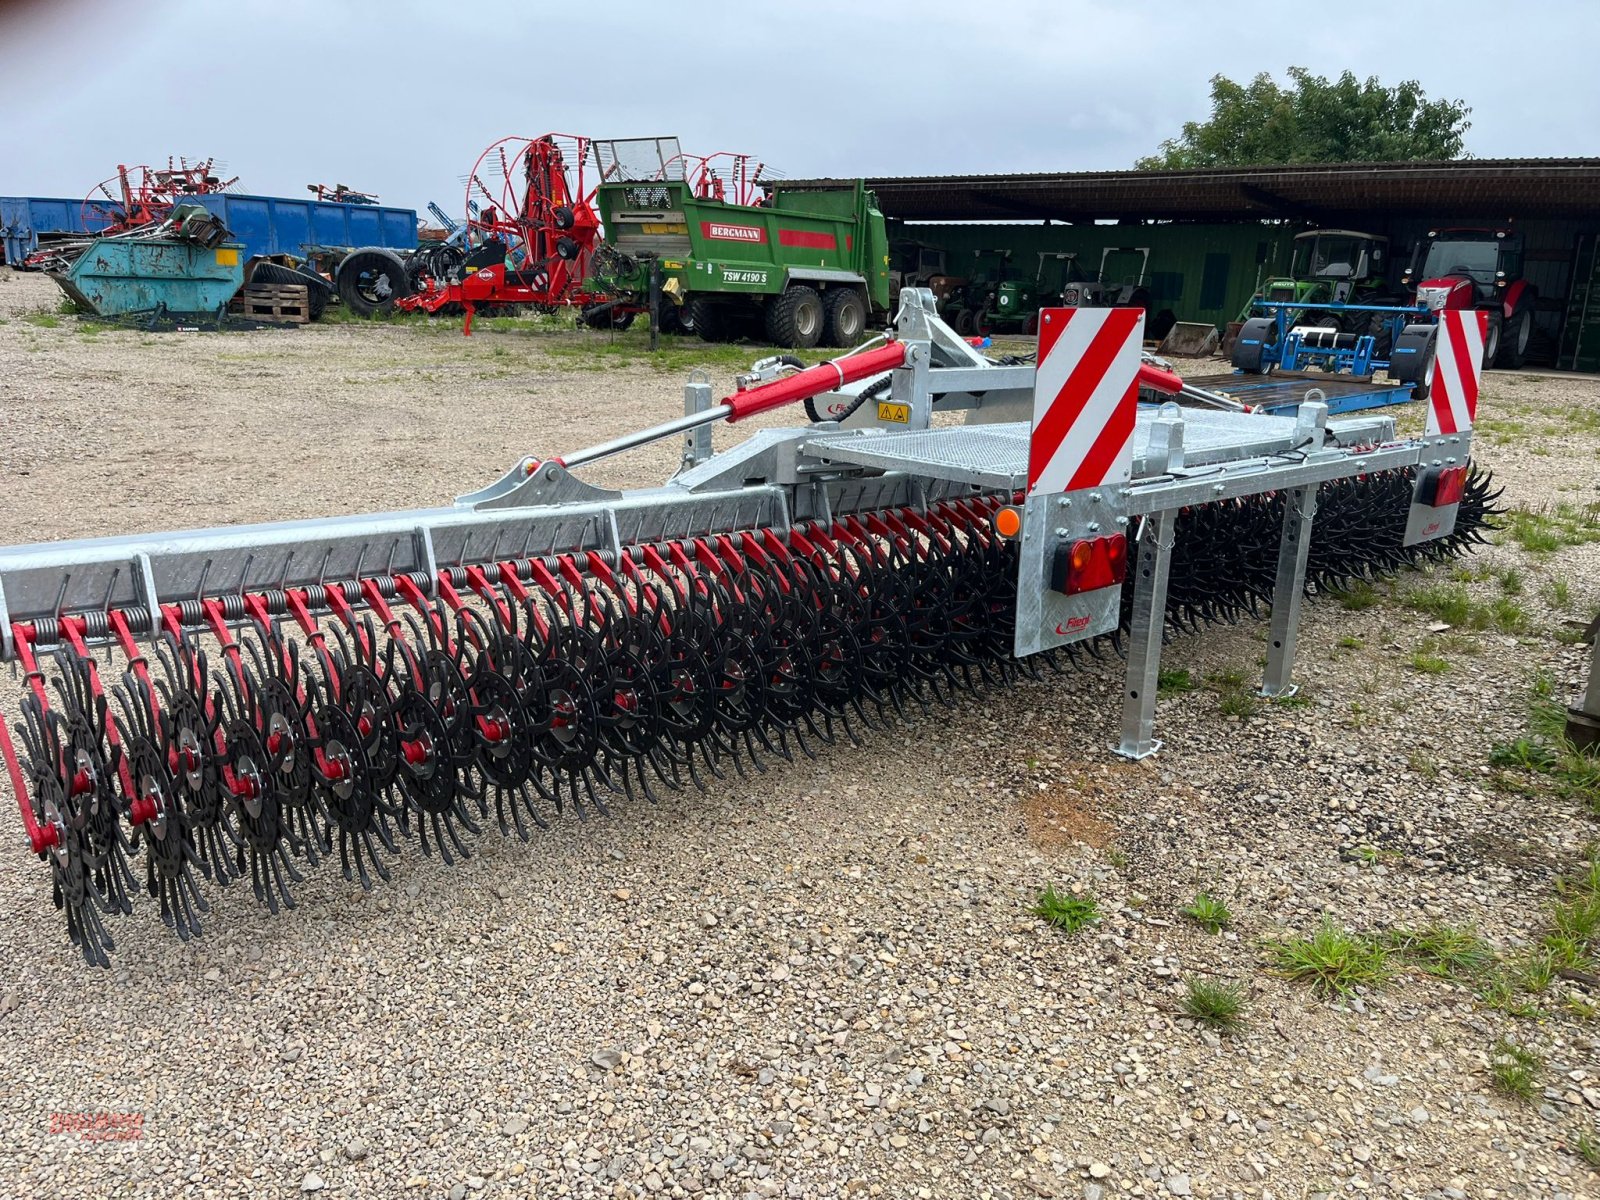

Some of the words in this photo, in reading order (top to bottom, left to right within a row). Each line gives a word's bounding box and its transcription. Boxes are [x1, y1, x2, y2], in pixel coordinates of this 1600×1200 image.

[712, 226, 758, 239] BERGMANN
[723, 271, 741, 281] TSW
[741, 272, 760, 282] 4190
[761, 273, 767, 282] S
[1066, 613, 1091, 629] Fliegl
